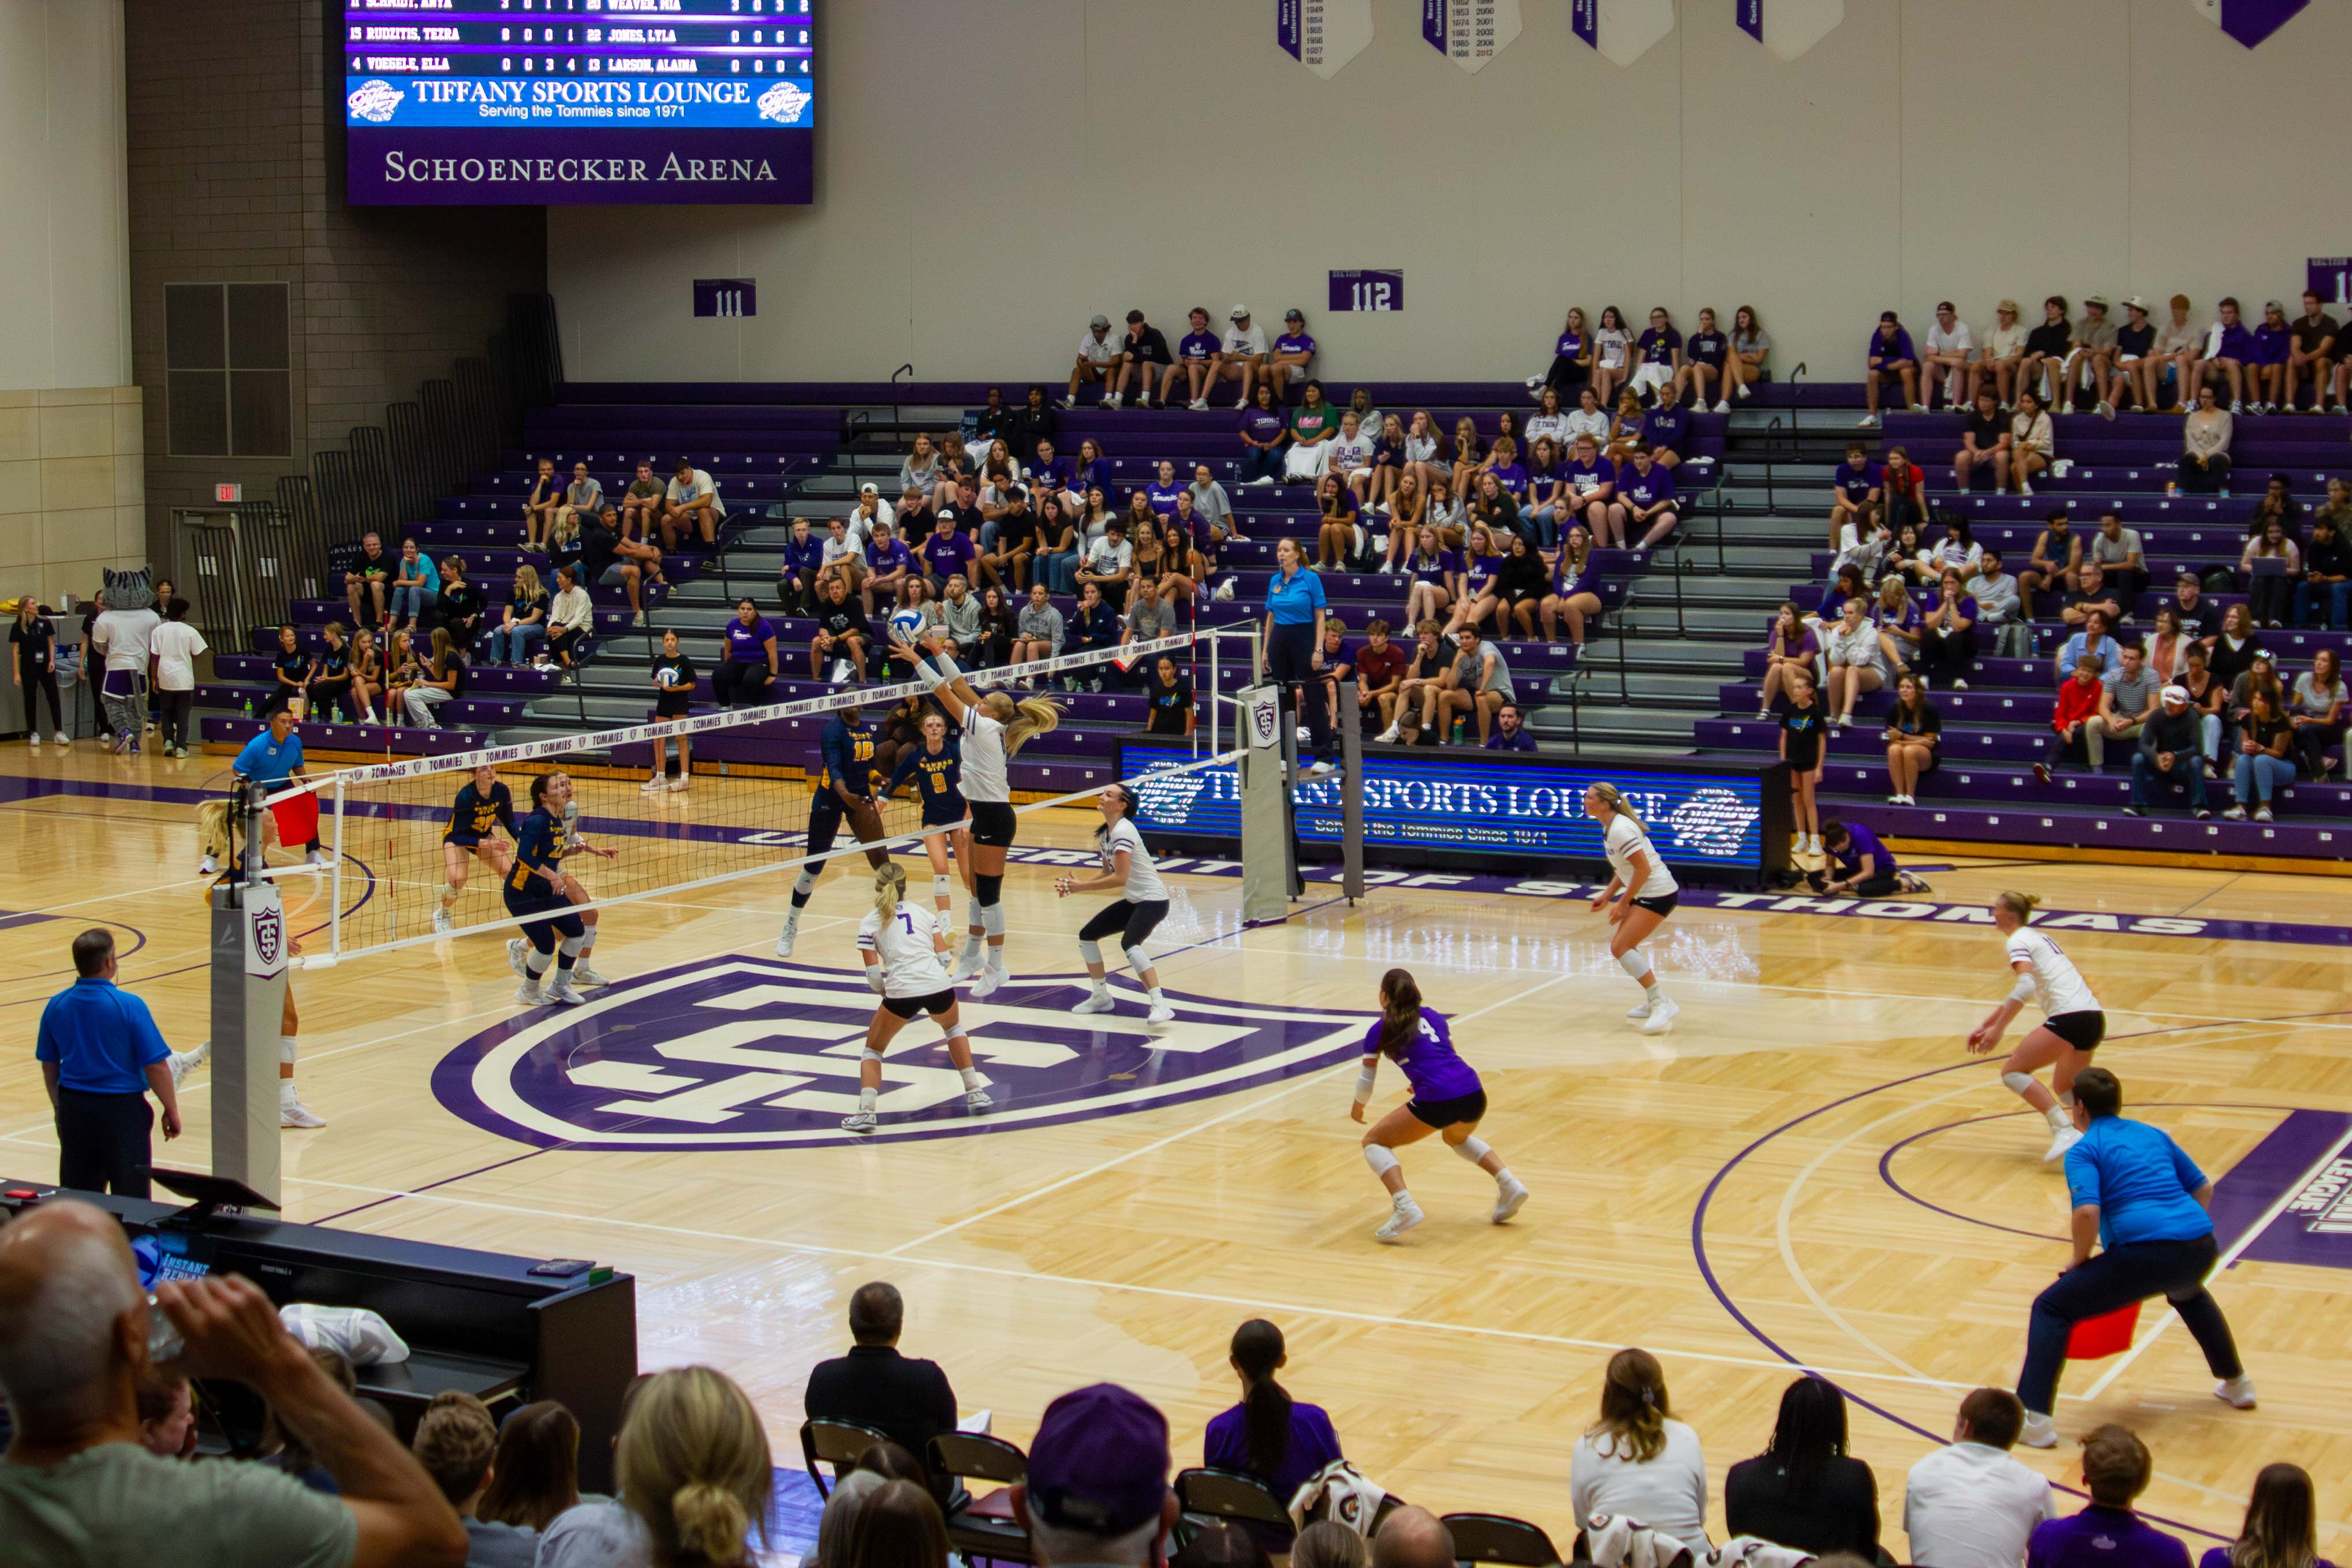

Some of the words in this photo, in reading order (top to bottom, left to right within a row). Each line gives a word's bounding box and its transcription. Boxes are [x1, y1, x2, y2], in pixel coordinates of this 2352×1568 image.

[524, 28, 532, 41] 0
[545, 28, 553, 41] 0
[568, 28, 574, 41] 1
[587, 29, 602, 42] 22
[608, 29, 646, 43] JONES,
[648, 29, 677, 42] LYLA
[753, 30, 761, 43] 0
[799, 30, 808, 43] 2
[352, 57, 361, 70] 4
[421, 57, 450, 70] ELLA
[502, 58, 511, 71] 0
[525, 58, 533, 71] 0
[546, 58, 554, 71] 3
[568, 58, 576, 71] 4
[608, 59, 654, 73] LARSON,
[754, 59, 763, 73] 0
[776, 59, 785, 73] 0
[800, 59, 808, 73] 4
[412, 81, 527, 103] TIFFANY
[532, 81, 631, 103] SPORTS
[637, 81, 750, 104] LOUNGE
[479, 104, 529, 120] Serving
[532, 105, 552, 117] the
[556, 105, 614, 118] Tommies
[617, 105, 651, 117] since
[655, 105, 685, 118] 1971
[386, 151, 649, 182] SCHOENECKER
[656, 151, 778, 181] ARENA
[716, 290, 742, 317] 111
[1352, 282, 1391, 311] 112
[371, 765, 406, 779] TOMMIES
[429, 756, 462, 770] TOMMIES
[486, 748, 518, 762] TOMMIES
[540, 741, 572, 754] TOMMIES
[593, 732, 624, 745] TOMMIES
[644, 725, 673, 738] TOMMIES
[693, 716, 721, 730] TOMMIES
[740, 710, 767, 722] TOMMIES
[785, 702, 812, 715] TOMMIES
[830, 695, 856, 707] TOMMIES
[872, 688, 897, 700] TOMMIES
[931, 773, 947, 793] 9
[1362, 778, 1498, 813] SPORTS
[897, 913, 915, 935] 7
[1418, 1017, 1440, 1043] 4
[162, 1252, 210, 1275] INSTANT
